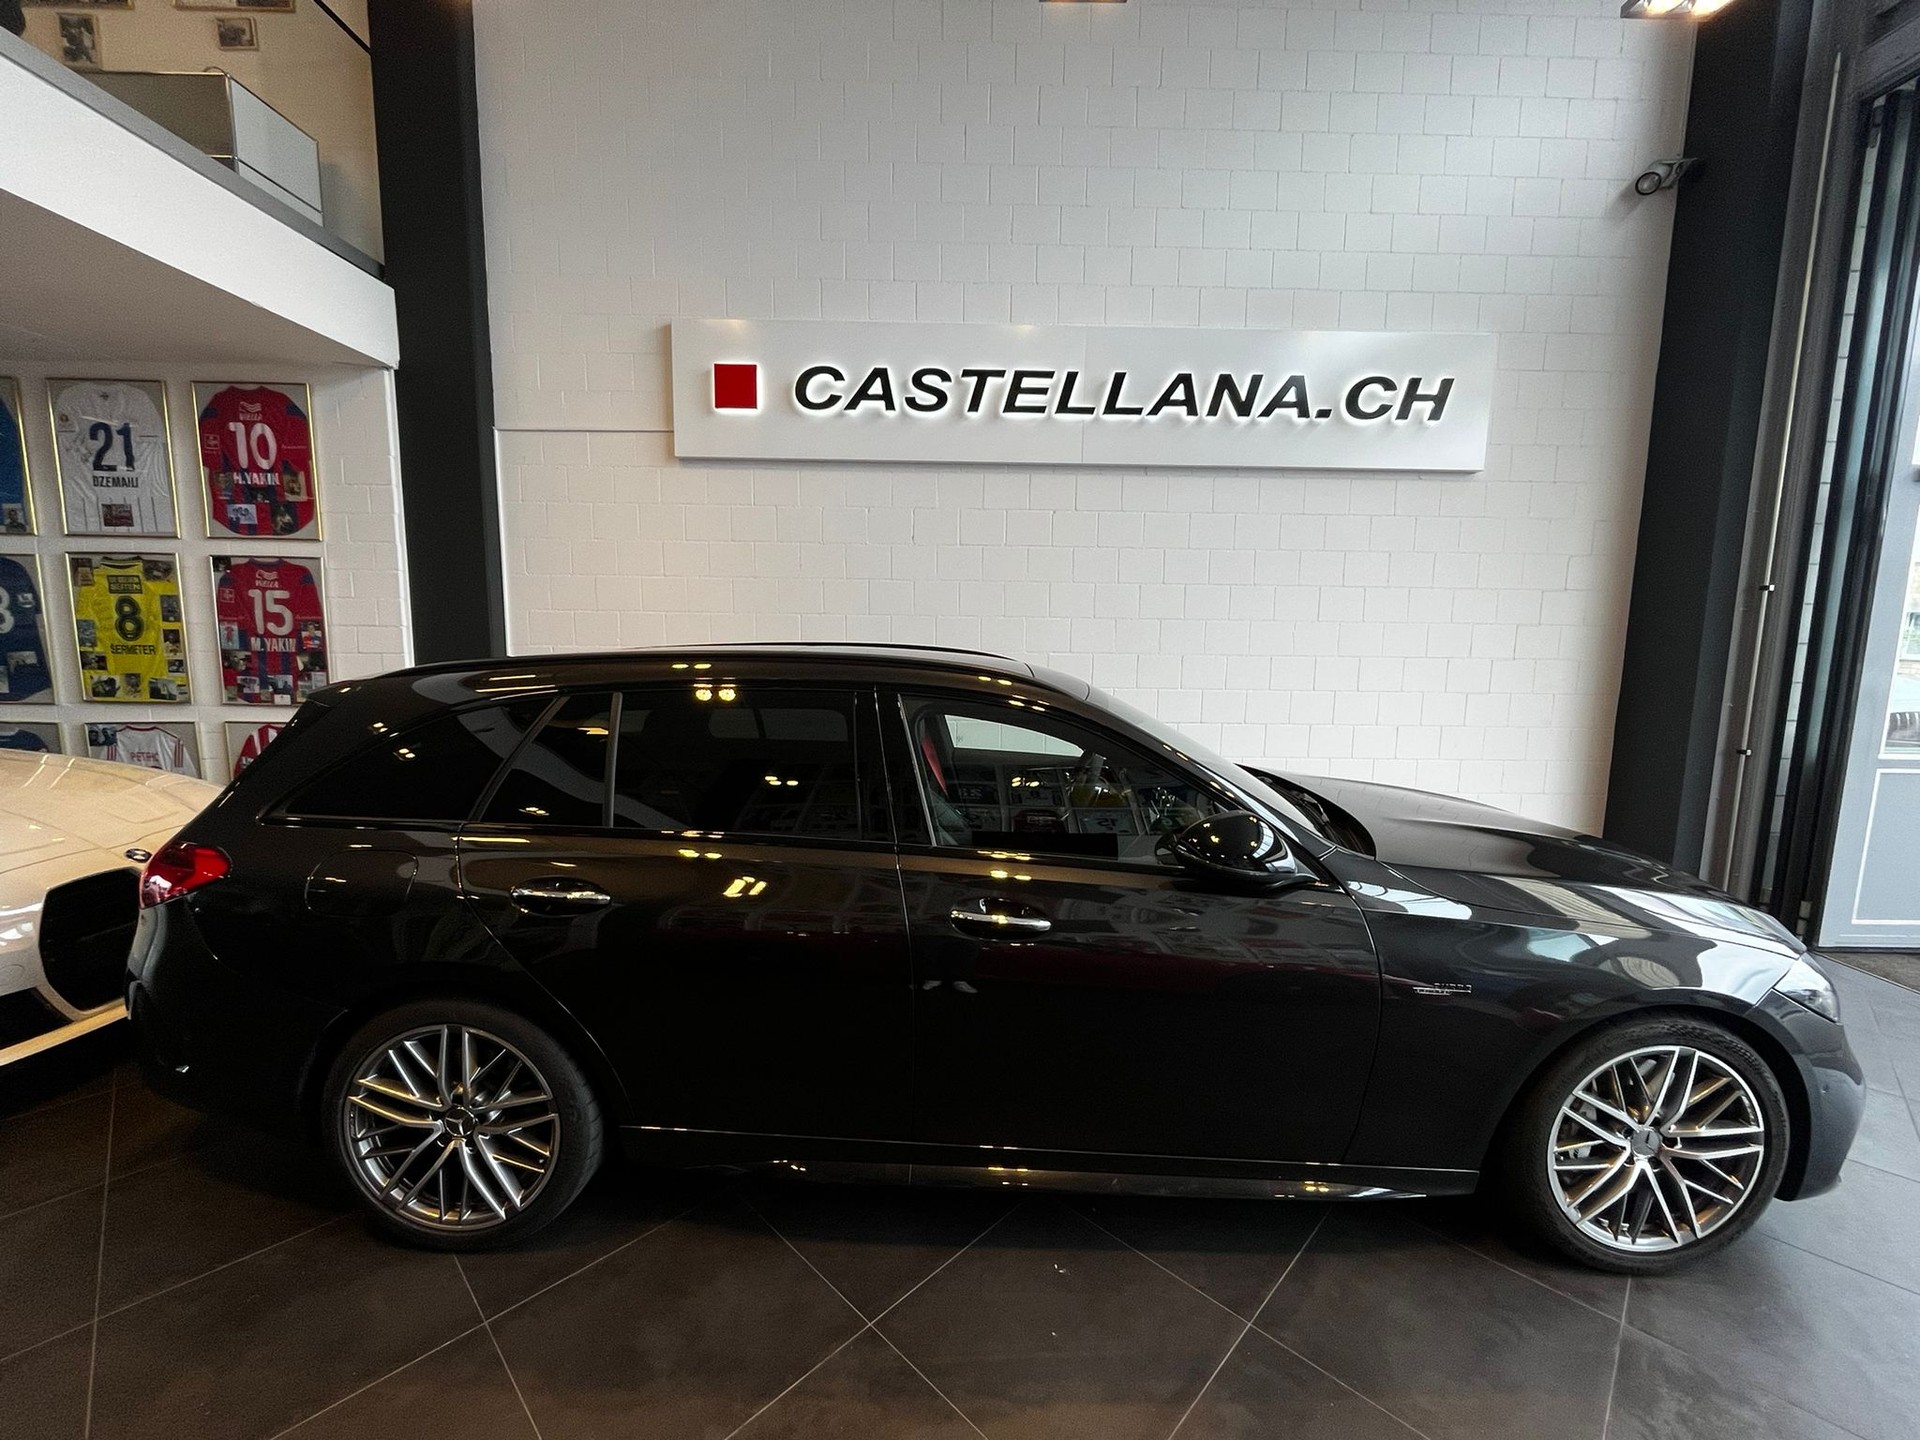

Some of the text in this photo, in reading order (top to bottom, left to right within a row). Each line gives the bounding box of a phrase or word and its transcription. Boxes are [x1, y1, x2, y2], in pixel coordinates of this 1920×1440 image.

[794, 366, 1456, 422] CASTELLANA.CH
[89, 422, 135, 472] 21
[228, 421, 278, 470] 10
[114, 595, 146, 642] 8
[248, 588, 294, 636] 15
